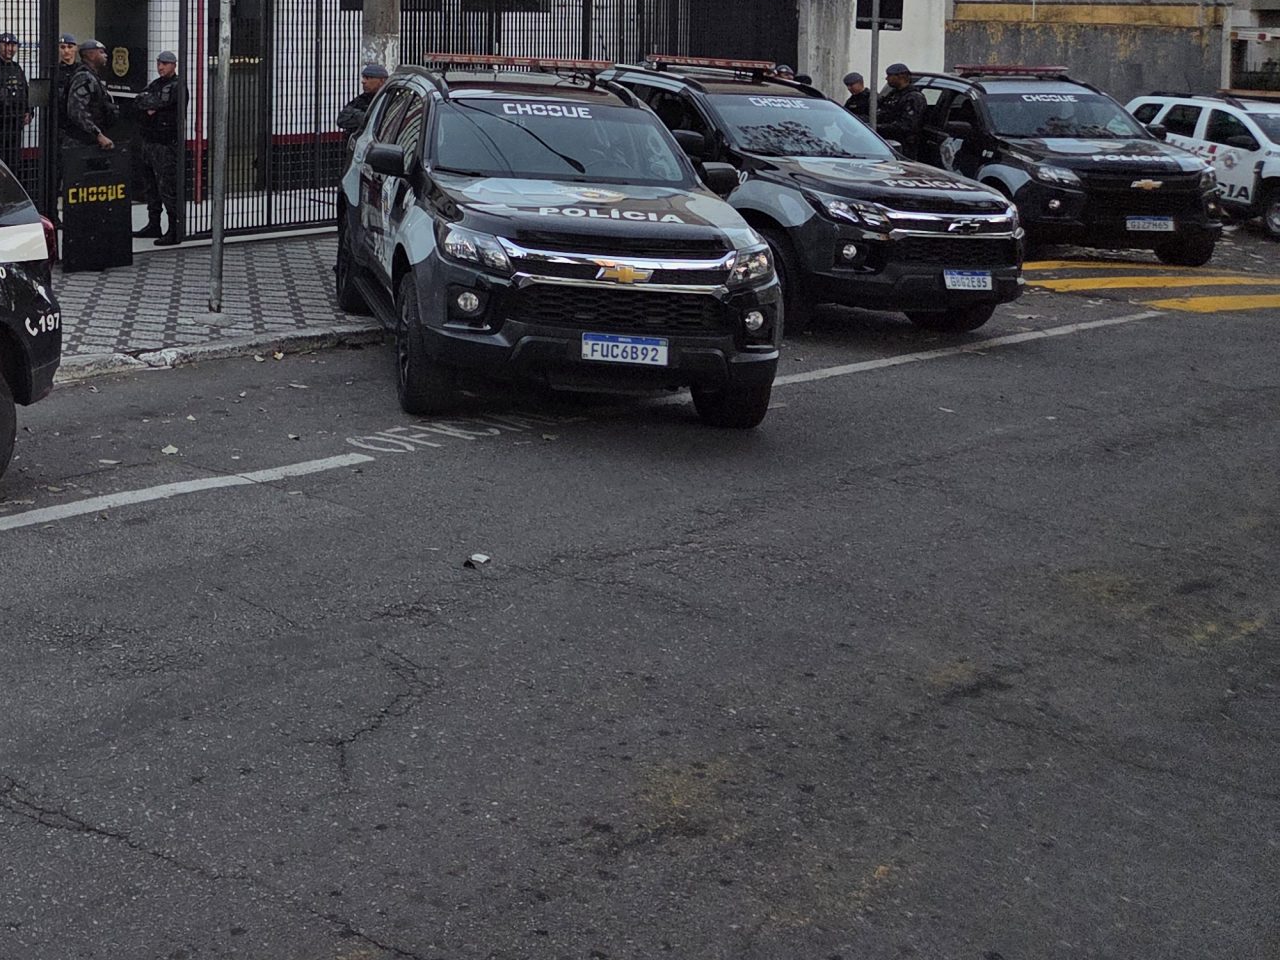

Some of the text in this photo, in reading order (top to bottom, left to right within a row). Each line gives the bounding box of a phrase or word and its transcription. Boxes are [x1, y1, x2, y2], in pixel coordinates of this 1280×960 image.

[1217, 182, 1249, 200] CIA
[539, 207, 685, 224] POLÍCIA
[38, 313, 60, 332] 197
[591, 342, 659, 362] FUC6B92
